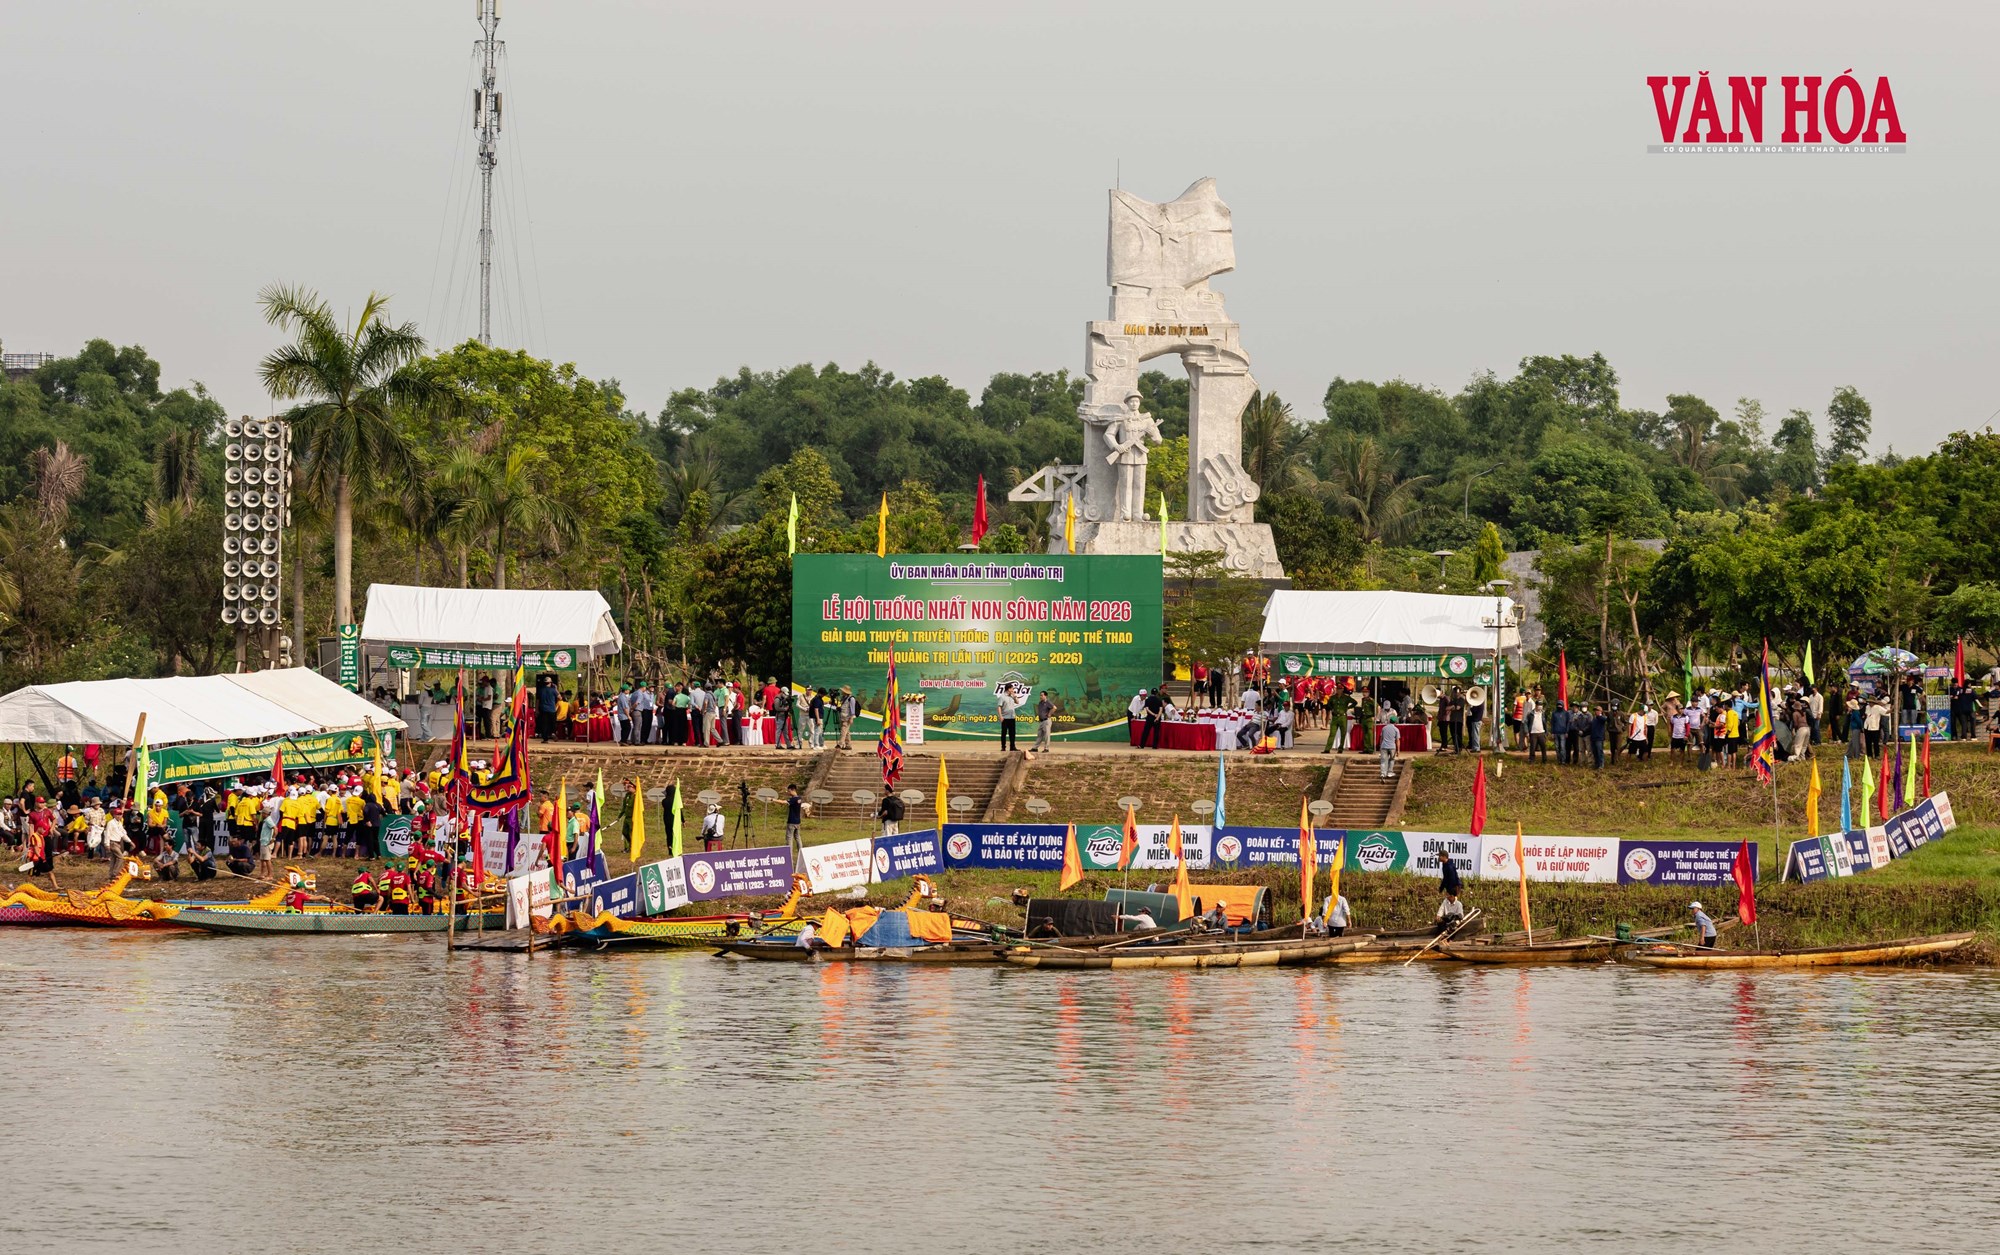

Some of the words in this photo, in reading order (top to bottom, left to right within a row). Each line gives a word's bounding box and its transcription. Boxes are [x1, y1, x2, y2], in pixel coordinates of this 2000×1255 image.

[890, 562, 905, 579] ỦY
[907, 566, 928, 579] BAN
[931, 563, 958, 579] NHÂN
[961, 563, 982, 579] DÂN
[985, 563, 1008, 579] TỈNH
[1010, 563, 1045, 580] QUẢNG
[1047, 566, 1064, 582] TRỊ
[823, 593, 840, 620] LỄ
[844, 595, 870, 624] HỘI
[873, 595, 924, 621] THỐNG
[928, 595, 967, 621] NHẤT
[971, 600, 1002, 621] NON
[1007, 596, 1048, 622] SÔNG
[1052, 596, 1087, 622] NĂM
[1090, 601, 1132, 622] 2026
[821, 627, 843, 643] GIẢI
[845, 630, 867, 643] ĐUA
[955, 628, 989, 643] THỐNG
[995, 631, 1013, 646] ĐẠI
[1016, 628, 1034, 646] HỘI
[1037, 628, 1057, 644] THỂ
[1059, 631, 1080, 646] DỤC
[1083, 629, 1104, 644] THỂ
[1105, 631, 1133, 644] THAO
[868, 648, 890, 663] TỈNH
[893, 648, 930, 664] QUẢNG
[933, 651, 949, 666] TRỊ
[975, 650, 995, 664] THỨ
[998, 652, 1003, 664] I
[1005, 652, 1039, 664] (2025
[1049, 652, 1083, 665] 2026)
[932, 713, 956, 723] Quảng
[969, 714, 987, 723] ngày
[1015, 714, 1034, 723] háng
[1058, 715, 1076, 723] 2026
[981, 832, 1005, 845] KHỎE
[1006, 831, 1019, 845] ĐỂ
[1020, 833, 1037, 846] XÂY
[1039, 834, 1063, 848] DỰNG
[1246, 836, 1269, 848] ĐOÀN
[1270, 835, 1286, 849] KẾT
[1319, 839, 1340, 852] THỰC
[1423, 838, 1444, 853] ĐẬM
[1447, 839, 1468, 854] TÌNH
[981, 847, 993, 859] VÀ
[994, 846, 1012, 860] BẢO
[1014, 847, 1025, 862] VỆ
[1026, 846, 1038, 860] TỔ
[1040, 846, 1063, 861] QUỐC
[1147, 845, 1171, 860] MIỀN
[1249, 851, 1265, 861] CAO
[1323, 852, 1335, 866] BỘ
[1357, 844, 1395, 859] huda
[1545, 843, 1557, 857] ĐỂ
[1558, 846, 1574, 860] LẬP
[1576, 846, 1608, 861] NGHIỆP
[1658, 850, 1671, 861] ĐẠI
[1671, 849, 1684, 861] HỘI
[1685, 848, 1699, 859] THỂ
[1700, 851, 1715, 861] DỤC
[1715, 848, 1730, 859] THỂ
[714, 861, 725, 872] ĐẠI
[725, 860, 735, 871] HỘI
[734, 857, 747, 869] THỂ
[747, 859, 759, 870] DỤC
[759, 855, 771, 867] THỂ
[771, 856, 786, 866] THAO
[1416, 853, 1440, 869] MIỀN
[1536, 860, 1548, 871] VÀ
[1550, 860, 1565, 872] GIỮ
[1566, 860, 1590, 872] NƯỚC
[1693, 860, 1718, 870] QUẢNG
[1719, 862, 1731, 871] TRỊ
[292, 873, 297, 885] 6
[744, 868, 764, 879] QUẢNG
[764, 868, 774, 879] TRỊ
[1697, 872, 1717, 881] (2025
